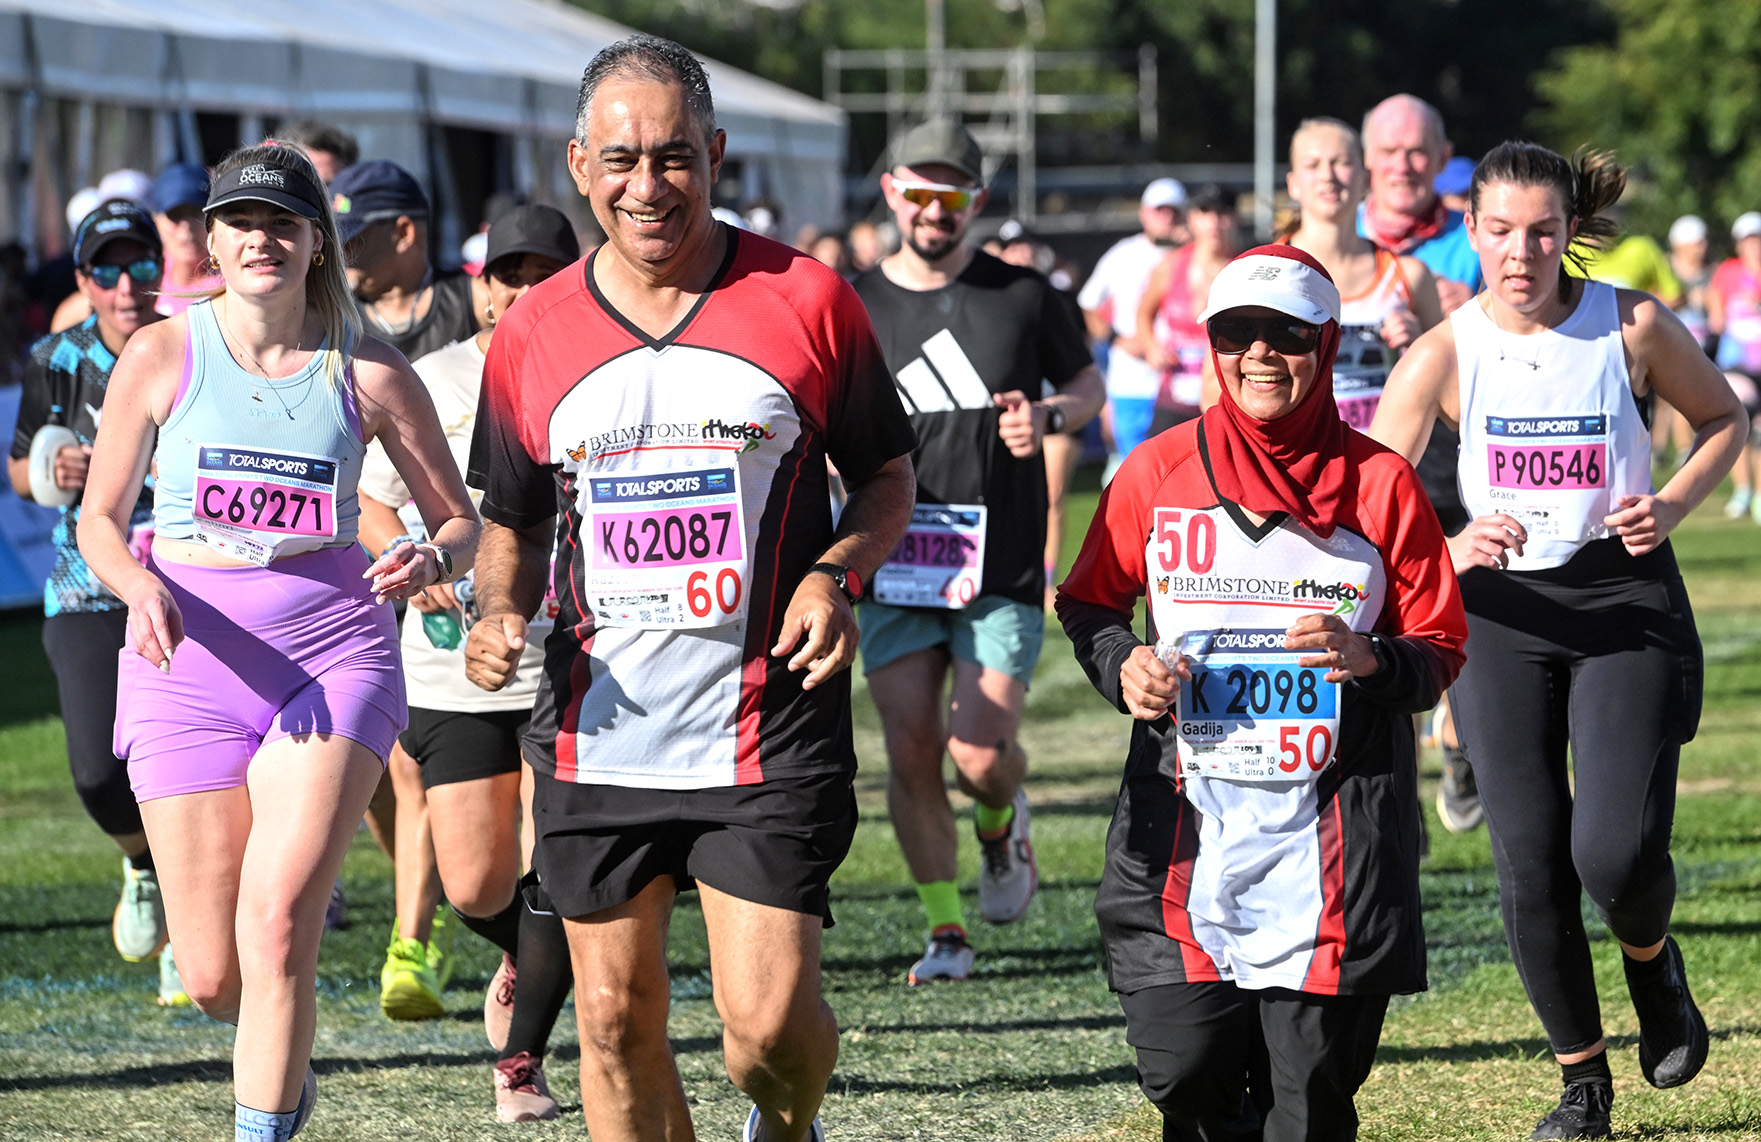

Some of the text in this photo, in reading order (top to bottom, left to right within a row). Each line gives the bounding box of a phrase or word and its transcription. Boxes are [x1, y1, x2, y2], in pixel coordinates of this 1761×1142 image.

[240, 173, 285, 184] OCEANS
[1508, 420, 1580, 434] TOTALSPORTS
[589, 423, 699, 451] BRIMSTONE
[229, 453, 308, 475] TOTALSPORTS
[1495, 449, 1600, 486] P90546
[275, 477, 300, 487] OCEANS
[300, 481, 332, 492] MARATHON
[616, 476, 700, 497] TOTALSPORTS
[666, 499, 694, 507] OCEANS
[696, 496, 736, 505] MARATHON
[1490, 489, 1516, 500] Grace
[203, 484, 322, 531] C69271
[602, 511, 732, 564] K62087
[1157, 511, 1217, 575] 50
[687, 567, 742, 618] 60
[1173, 577, 1290, 596] BRIMSTONE
[655, 606, 670, 614] Half
[679, 614, 685, 622] 2
[1213, 634, 1287, 648] TOTALSPOR
[1191, 669, 1318, 714] K 2098
[1182, 722, 1224, 738] Gadija
[1278, 724, 1332, 773] 50
[1244, 758, 1260, 766] Half
[1244, 767, 1274, 776] Ultra 0
